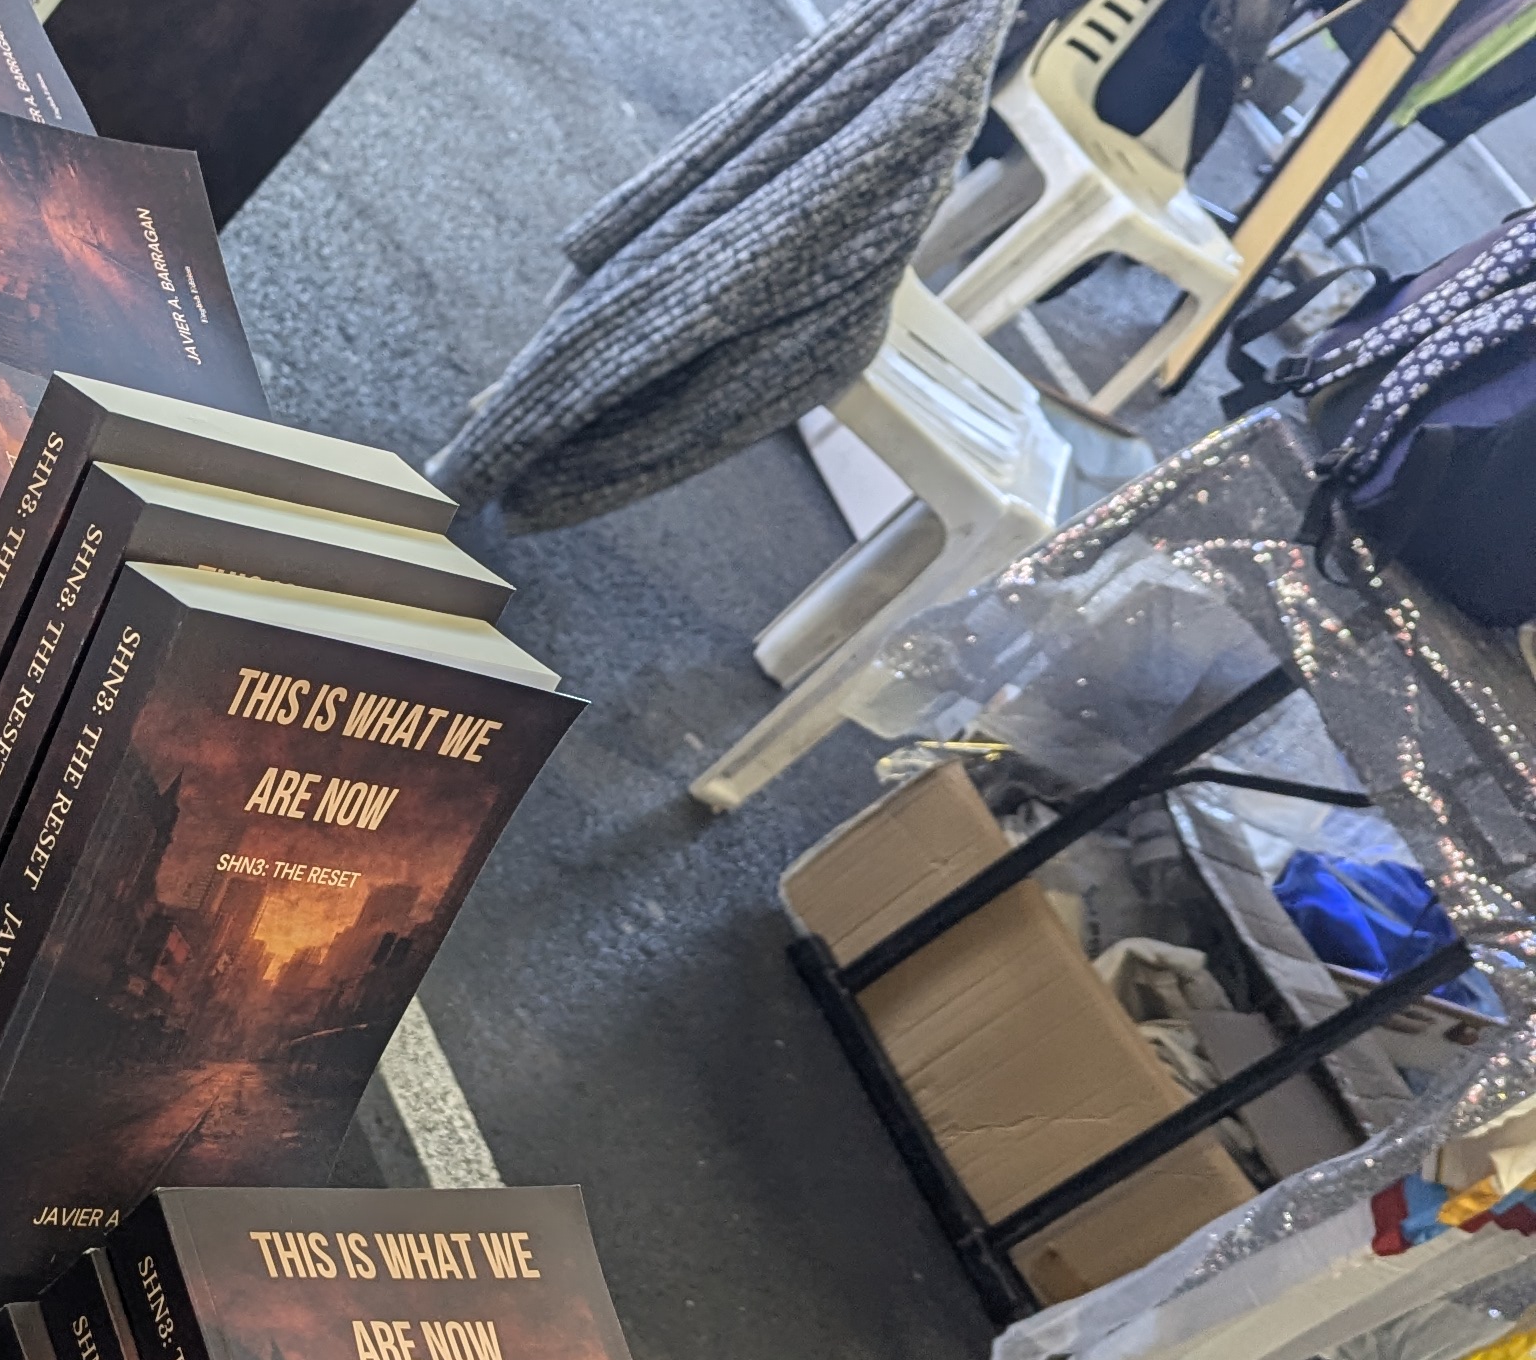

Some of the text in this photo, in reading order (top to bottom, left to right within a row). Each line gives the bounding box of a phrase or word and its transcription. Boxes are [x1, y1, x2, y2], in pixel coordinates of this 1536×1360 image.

[137, 207, 201, 365] JAVIER A. BARRAGAN
[17, 431, 64, 518] SHN3:
[56, 523, 104, 612] SHN3:
[28, 620, 65, 684] THE
[227, 667, 504, 763] THIS IS WHAT WE
[244, 766, 400, 831] ARE NOW
[216, 853, 362, 890] SHN3: THE RESET
[250, 1231, 541, 1280] THIS IS WHAT WE
[137, 1255, 173, 1348] SHN3:
